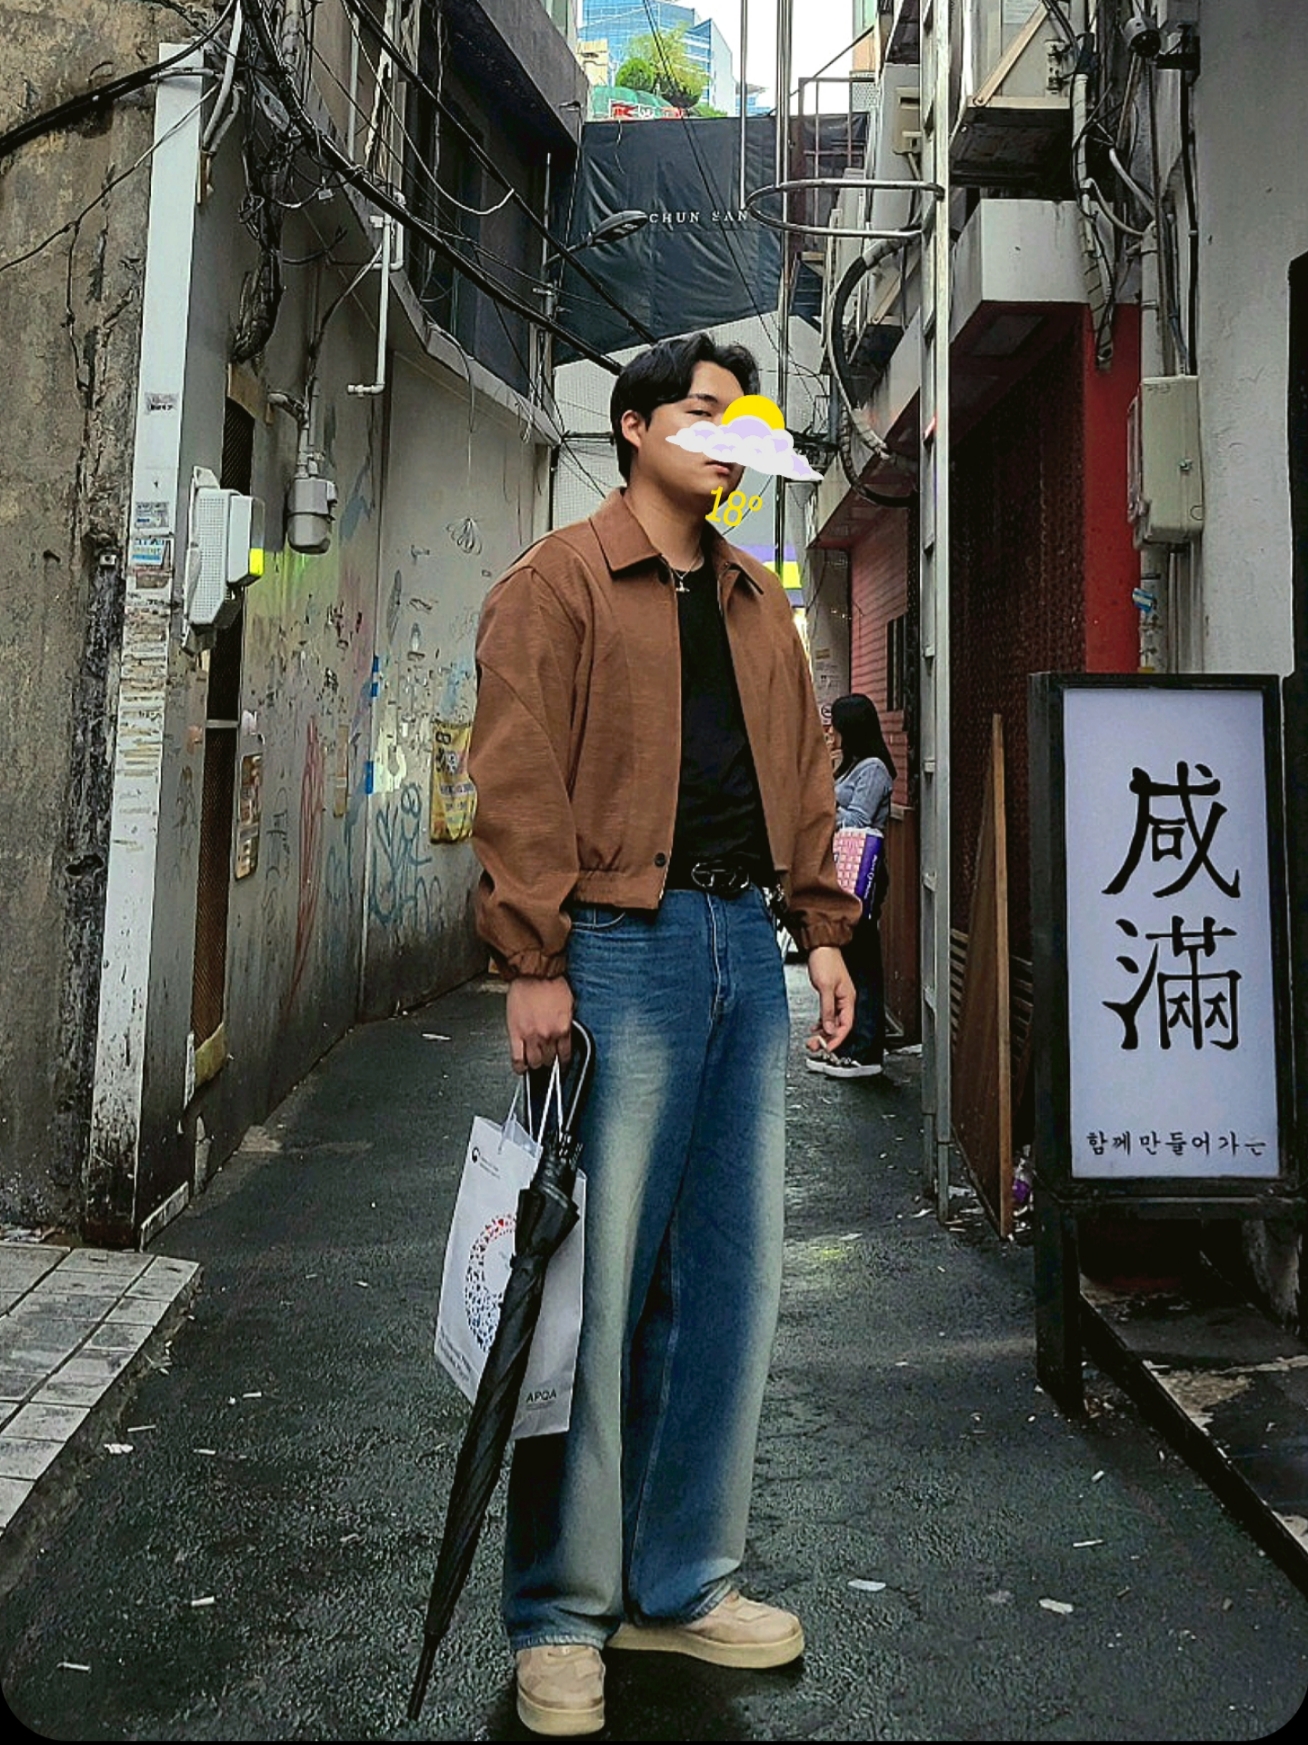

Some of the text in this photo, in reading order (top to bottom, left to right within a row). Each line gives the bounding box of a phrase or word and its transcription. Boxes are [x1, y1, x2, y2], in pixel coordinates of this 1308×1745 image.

[648, 209, 758, 224] CHUN SAN
[1086, 1130, 1131, 1157] 함께
[1139, 1130, 1210, 1157] 만들어
